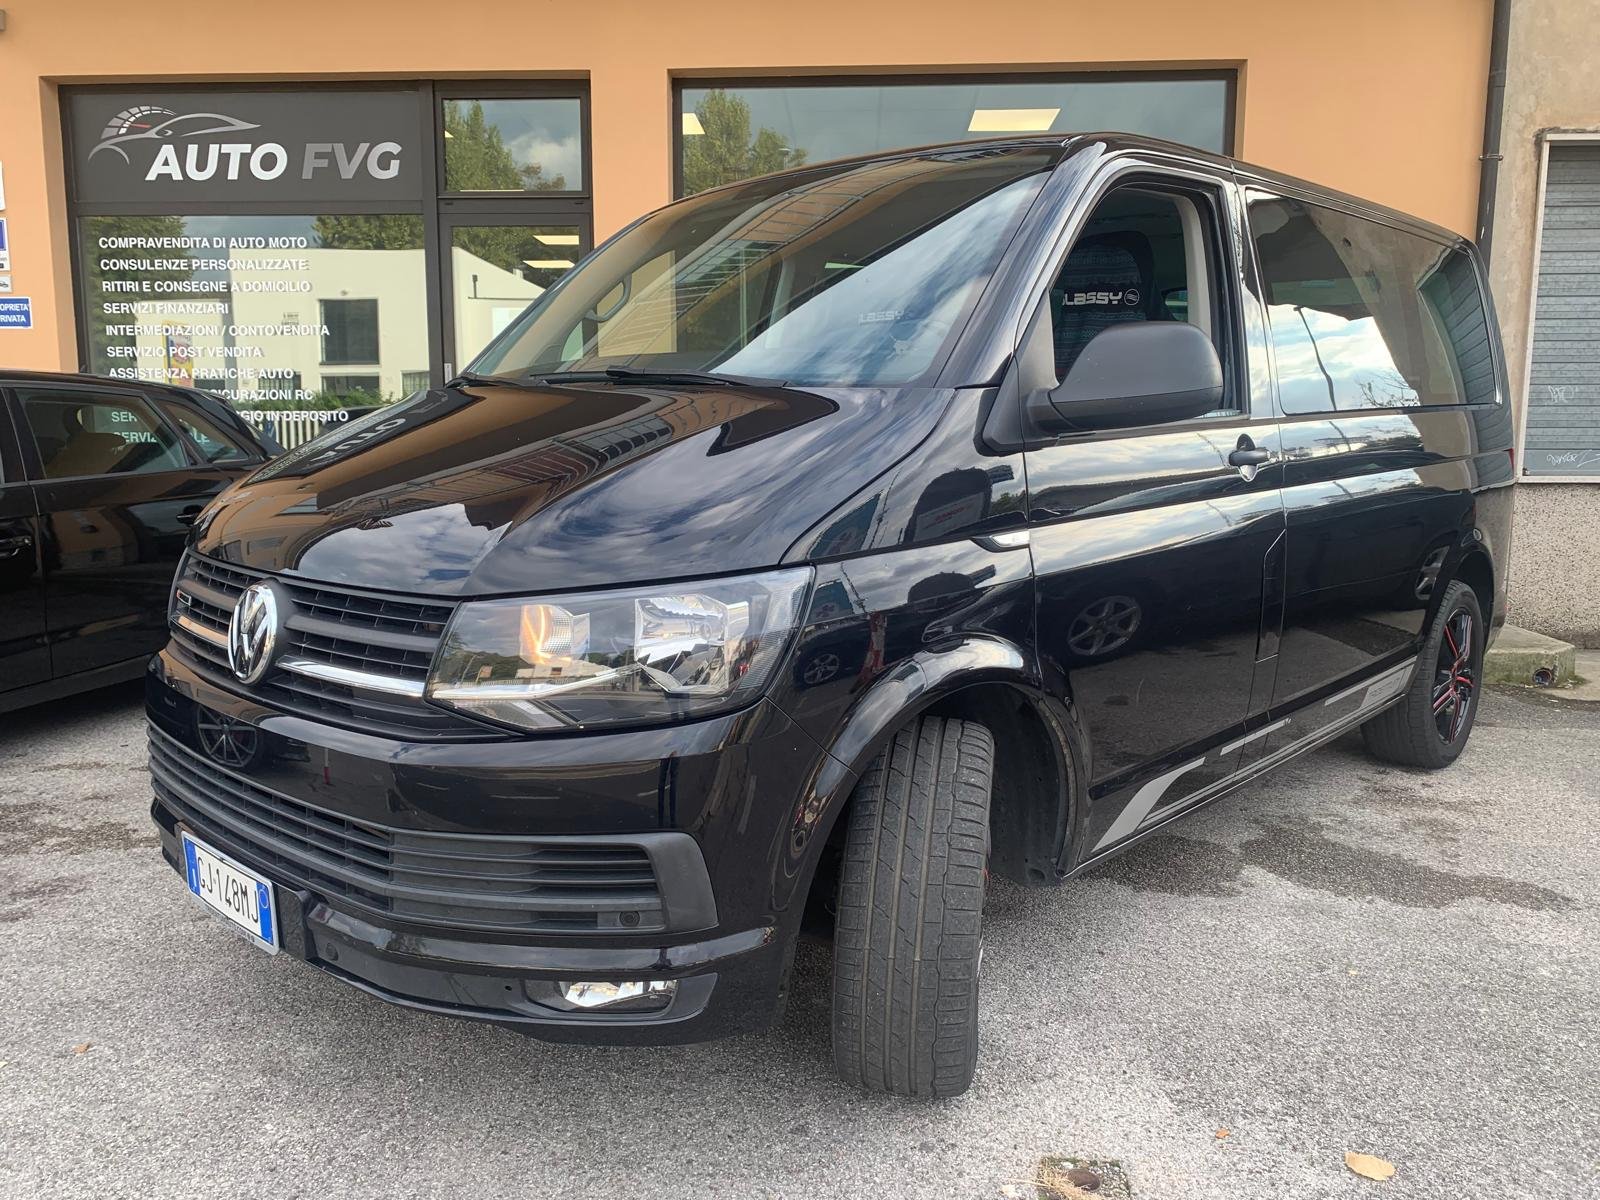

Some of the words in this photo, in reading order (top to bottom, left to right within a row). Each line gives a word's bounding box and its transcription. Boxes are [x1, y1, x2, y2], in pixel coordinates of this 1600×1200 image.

[145, 142, 289, 181] AUTO
[301, 141, 402, 180] FVG
[98, 236, 210, 249] COMPRAVENDITA
[213, 236, 226, 249] DI
[229, 236, 266, 249] AUTO
[268, 236, 308, 249] MOTO
[100, 258, 189, 271] CONSULENZE
[191, 258, 309, 271] PERSONALIZZATE
[102, 280, 140, 293] RITIRI
[142, 280, 151, 293] E
[153, 280, 228, 293] CONSEGNE
[230, 280, 241, 293] A
[243, 280, 311, 293] DOMICILIO
[103, 302, 153, 315] SERVIZI
[156, 302, 229, 315] FINANZIARI
[105, 324, 218, 337] INTERMEDIAZIONI
[228, 324, 331, 337] CONTOVENDITA
[106, 346, 167, 359] SERVIZIO
[169, 346, 204, 359] POST
[207, 346, 263, 359] VENDITA
[108, 367, 190, 380] ASSISTENZA
[192, 367, 256, 380] PRATICHE
[257, 367, 295, 380] AUTO
[295, 388, 314, 401] RC
[266, 410, 281, 423] IN
[282, 410, 349, 423] DEPOSITO
